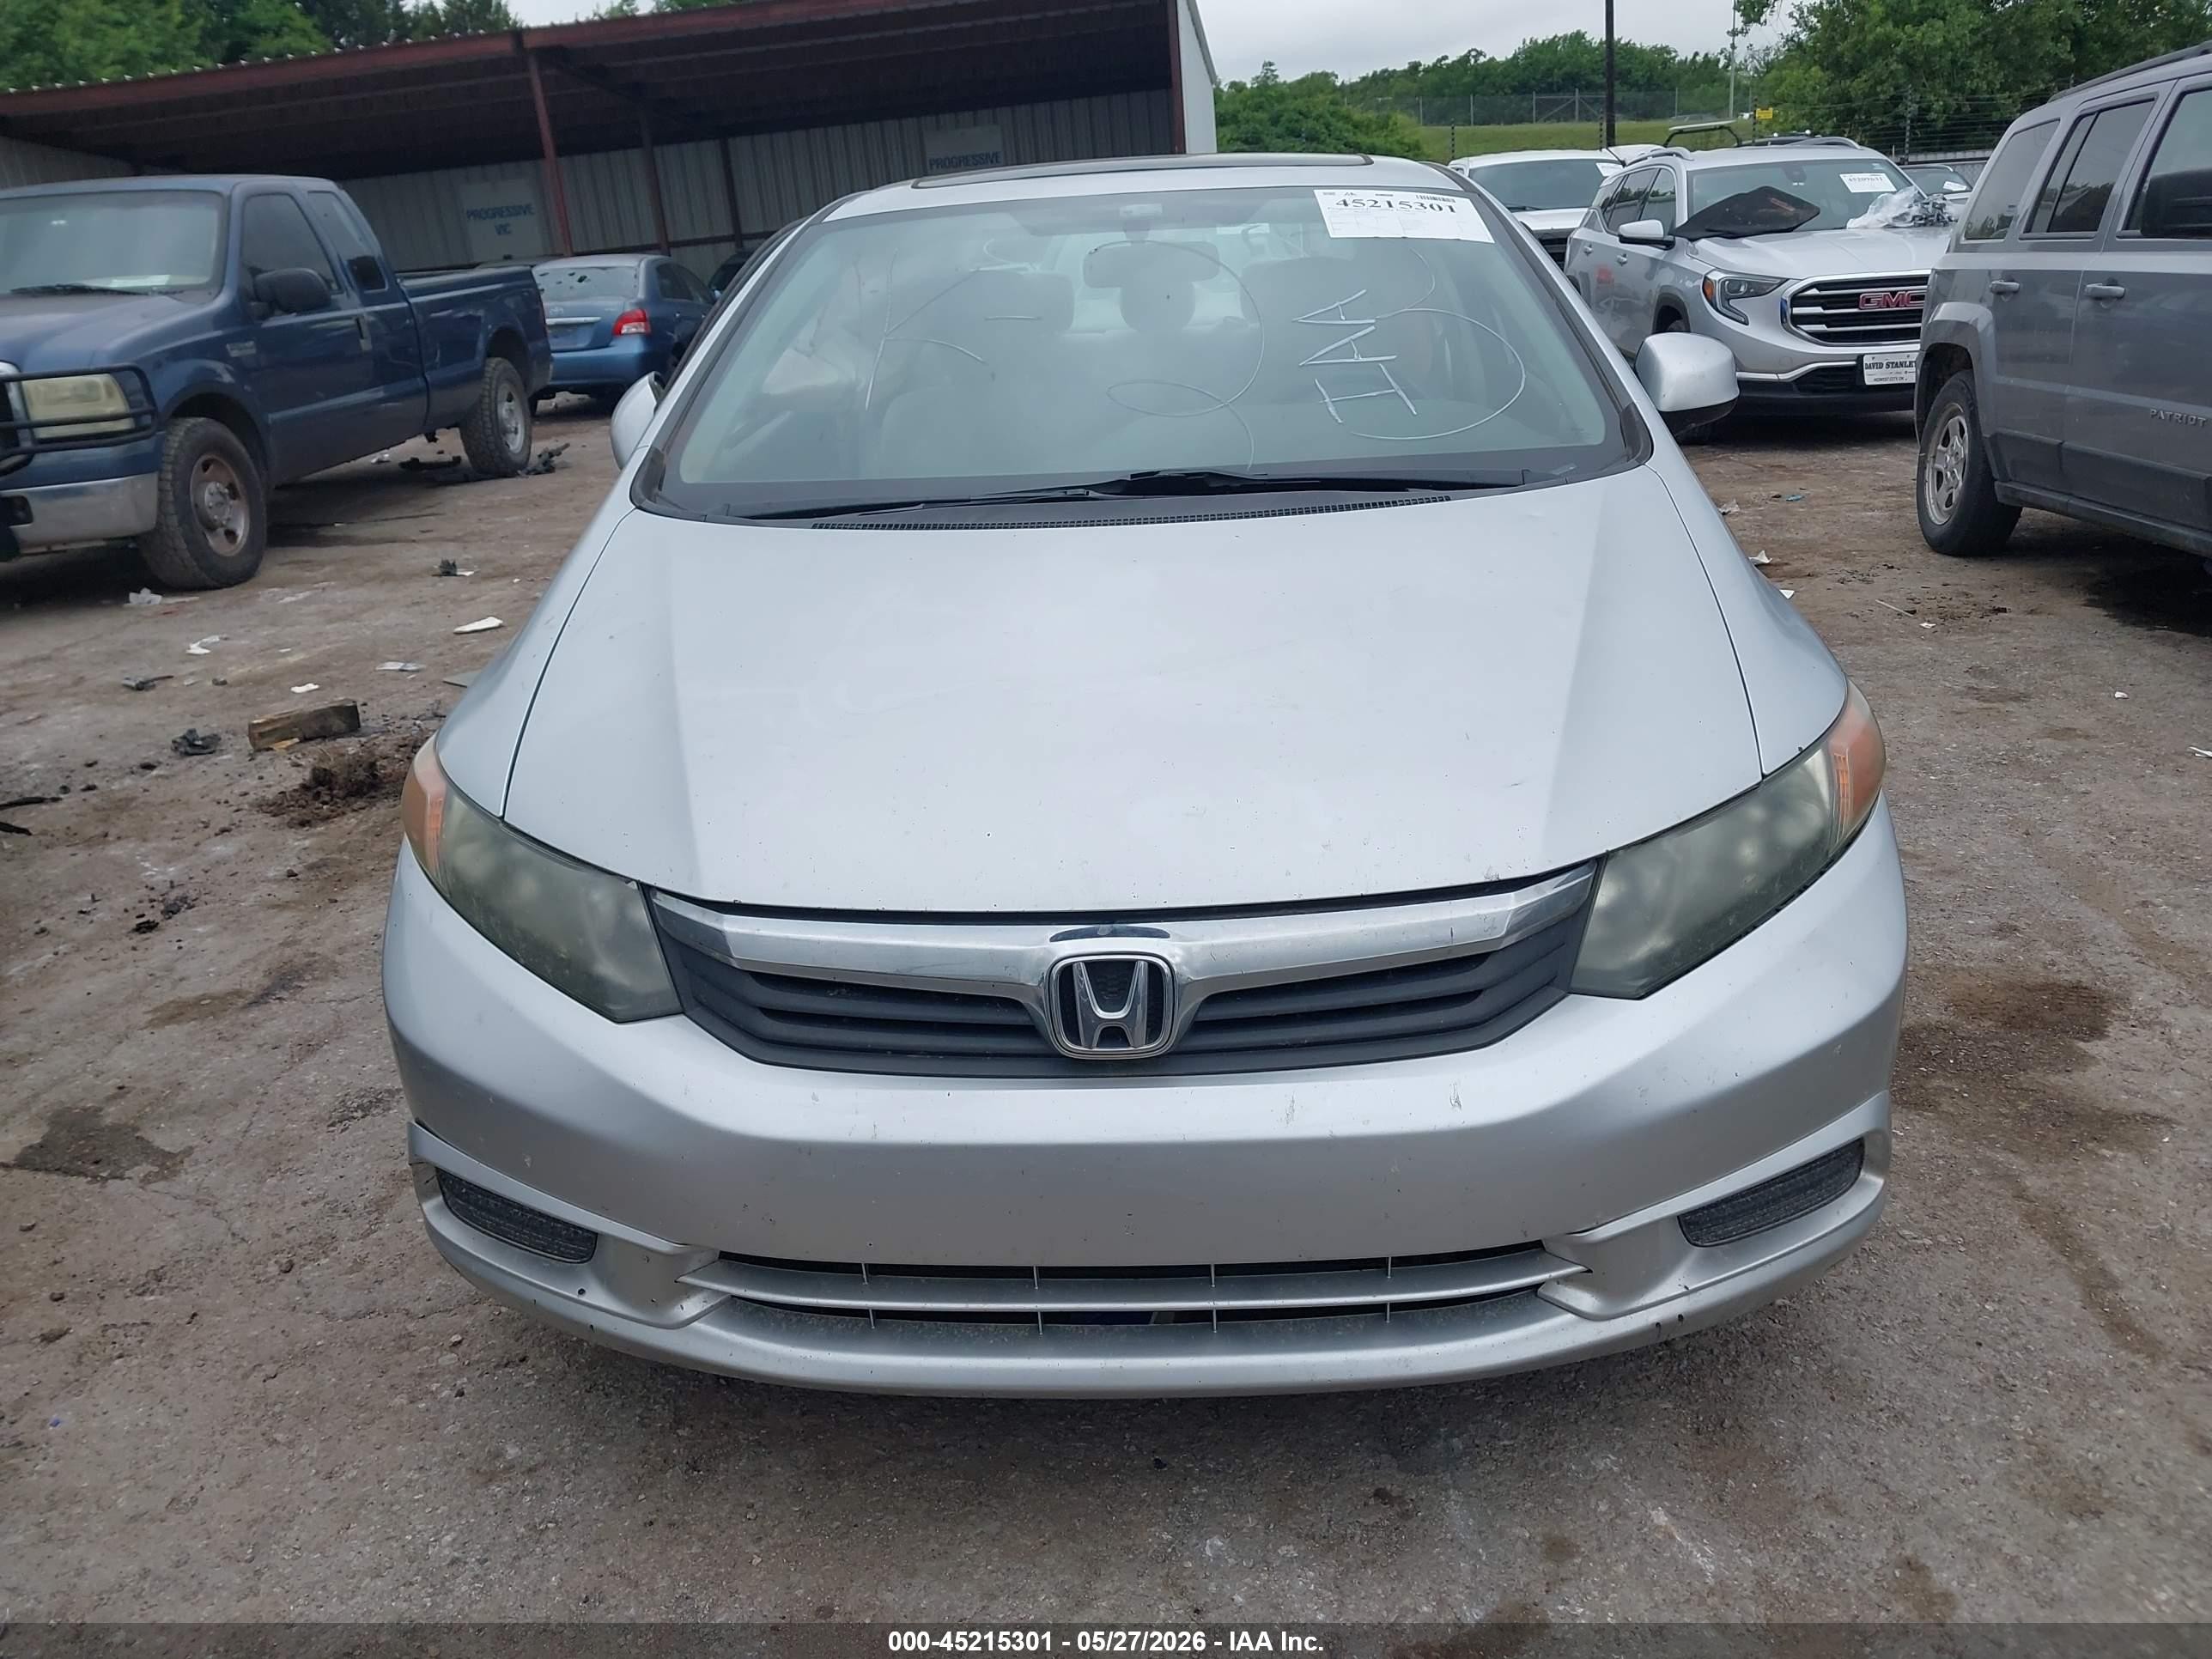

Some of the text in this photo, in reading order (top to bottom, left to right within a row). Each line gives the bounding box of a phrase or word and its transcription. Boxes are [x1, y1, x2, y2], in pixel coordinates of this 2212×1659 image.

[928, 152, 1002, 169] PROGRESSIVE
[466, 204, 535, 221] PROGRESSIVE
[1335, 198, 1456, 214] 45215301
[1859, 290, 1926, 310] GMC
[1864, 362, 1884, 370] DAVID
[2149, 408, 2207, 428] PATRIOT
